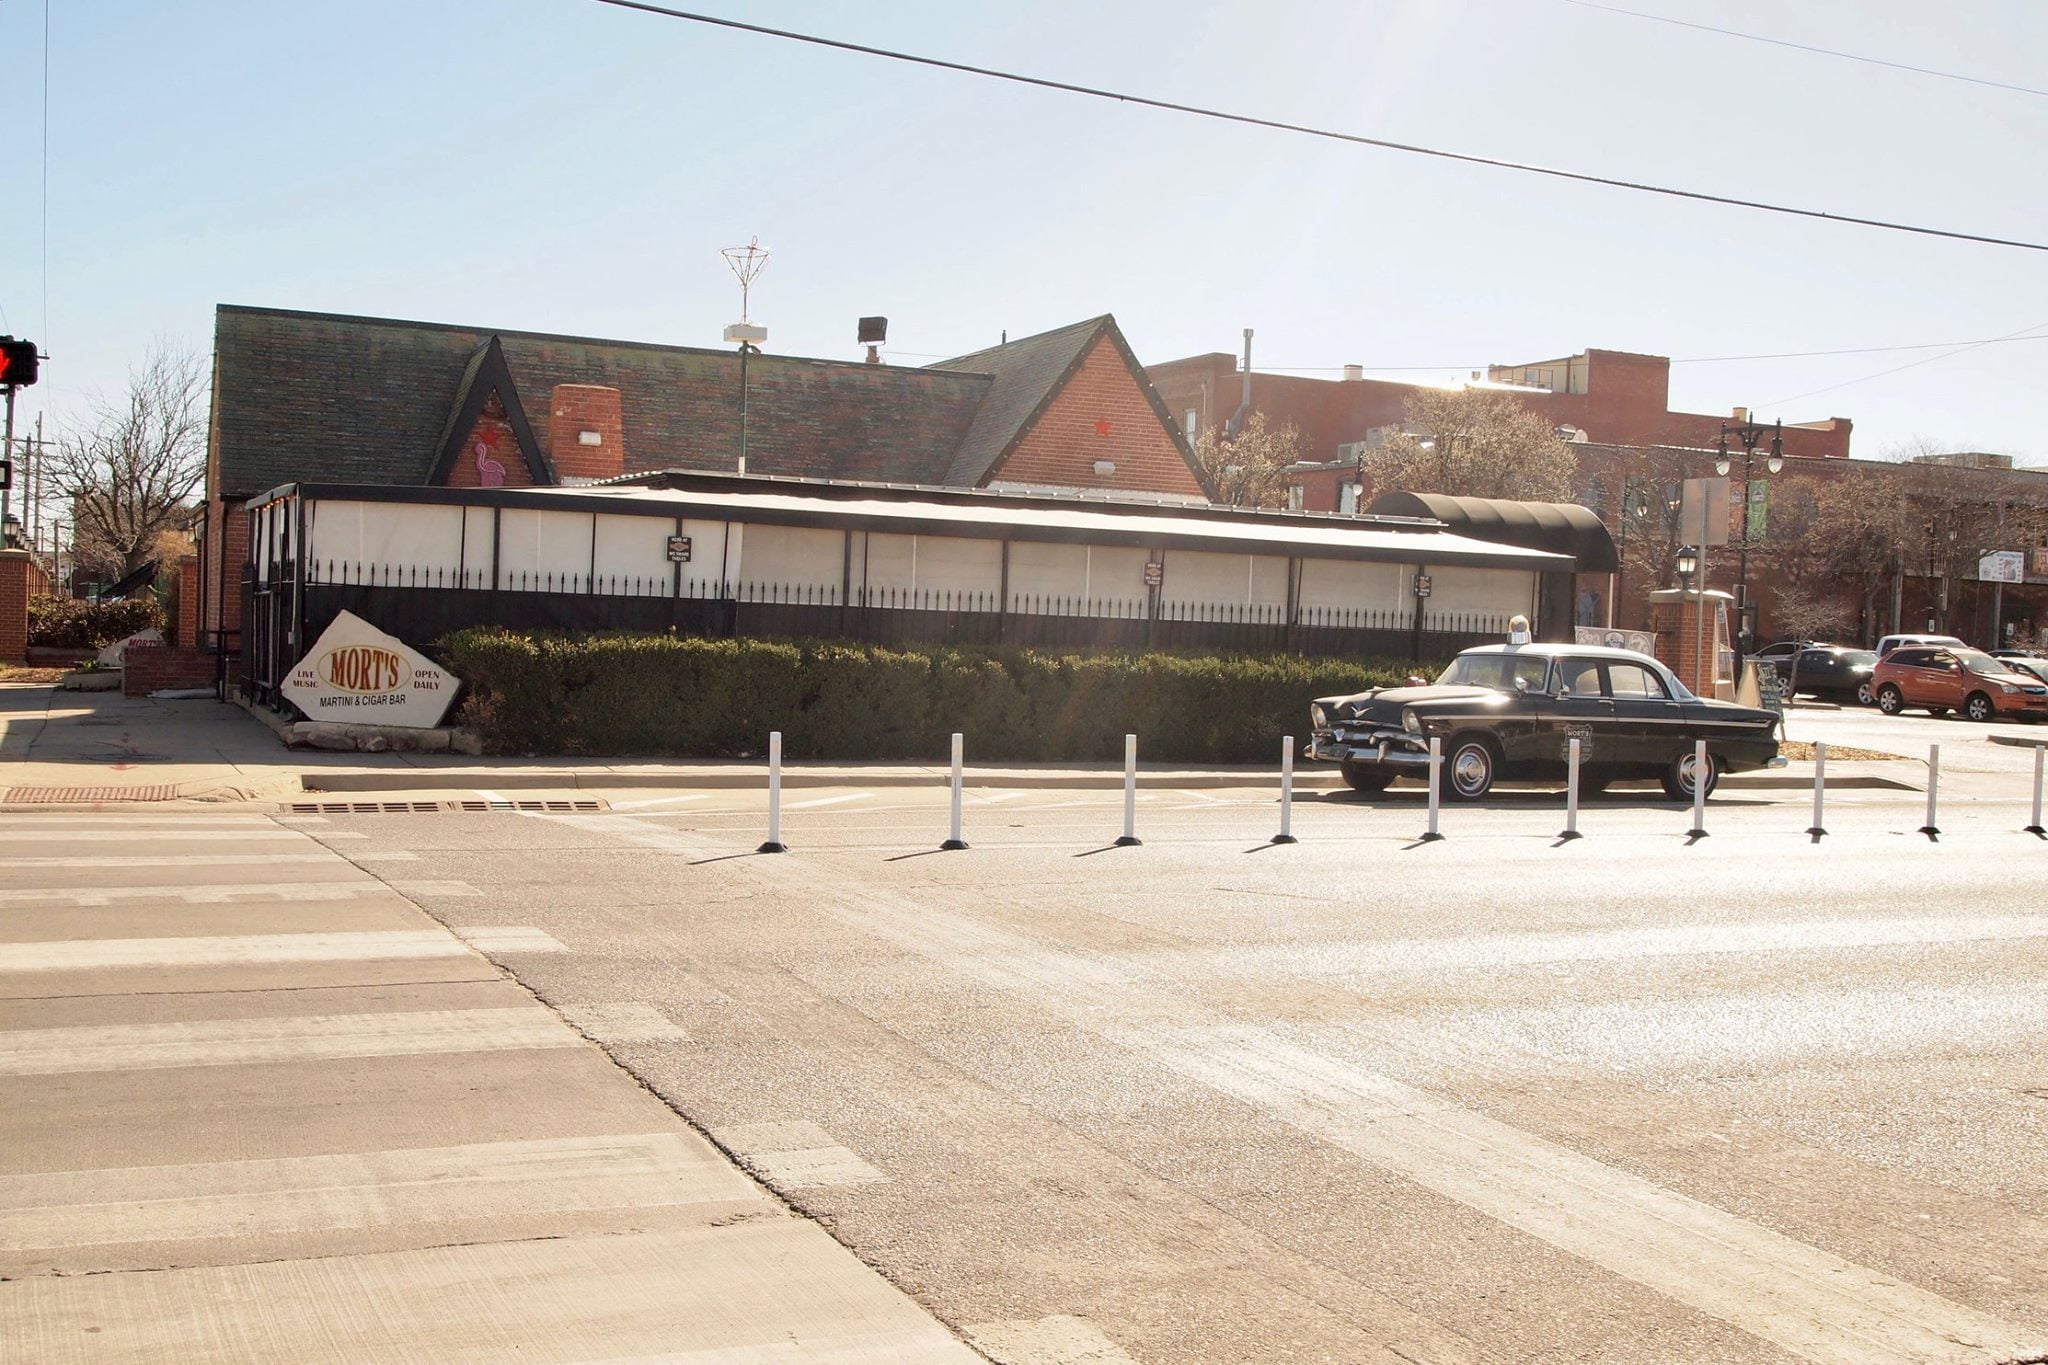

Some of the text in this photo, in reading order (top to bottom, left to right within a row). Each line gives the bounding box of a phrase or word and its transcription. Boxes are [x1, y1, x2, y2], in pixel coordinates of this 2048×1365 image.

[330, 648, 399, 690] MORT'S
[297, 670, 315, 678] LIVE
[415, 669, 440, 679] OPEN
[293, 680, 320, 688] MUSIC
[413, 681, 440, 690] DAILY
[320, 693, 406, 707] MARTINI & CIGAR BAR
